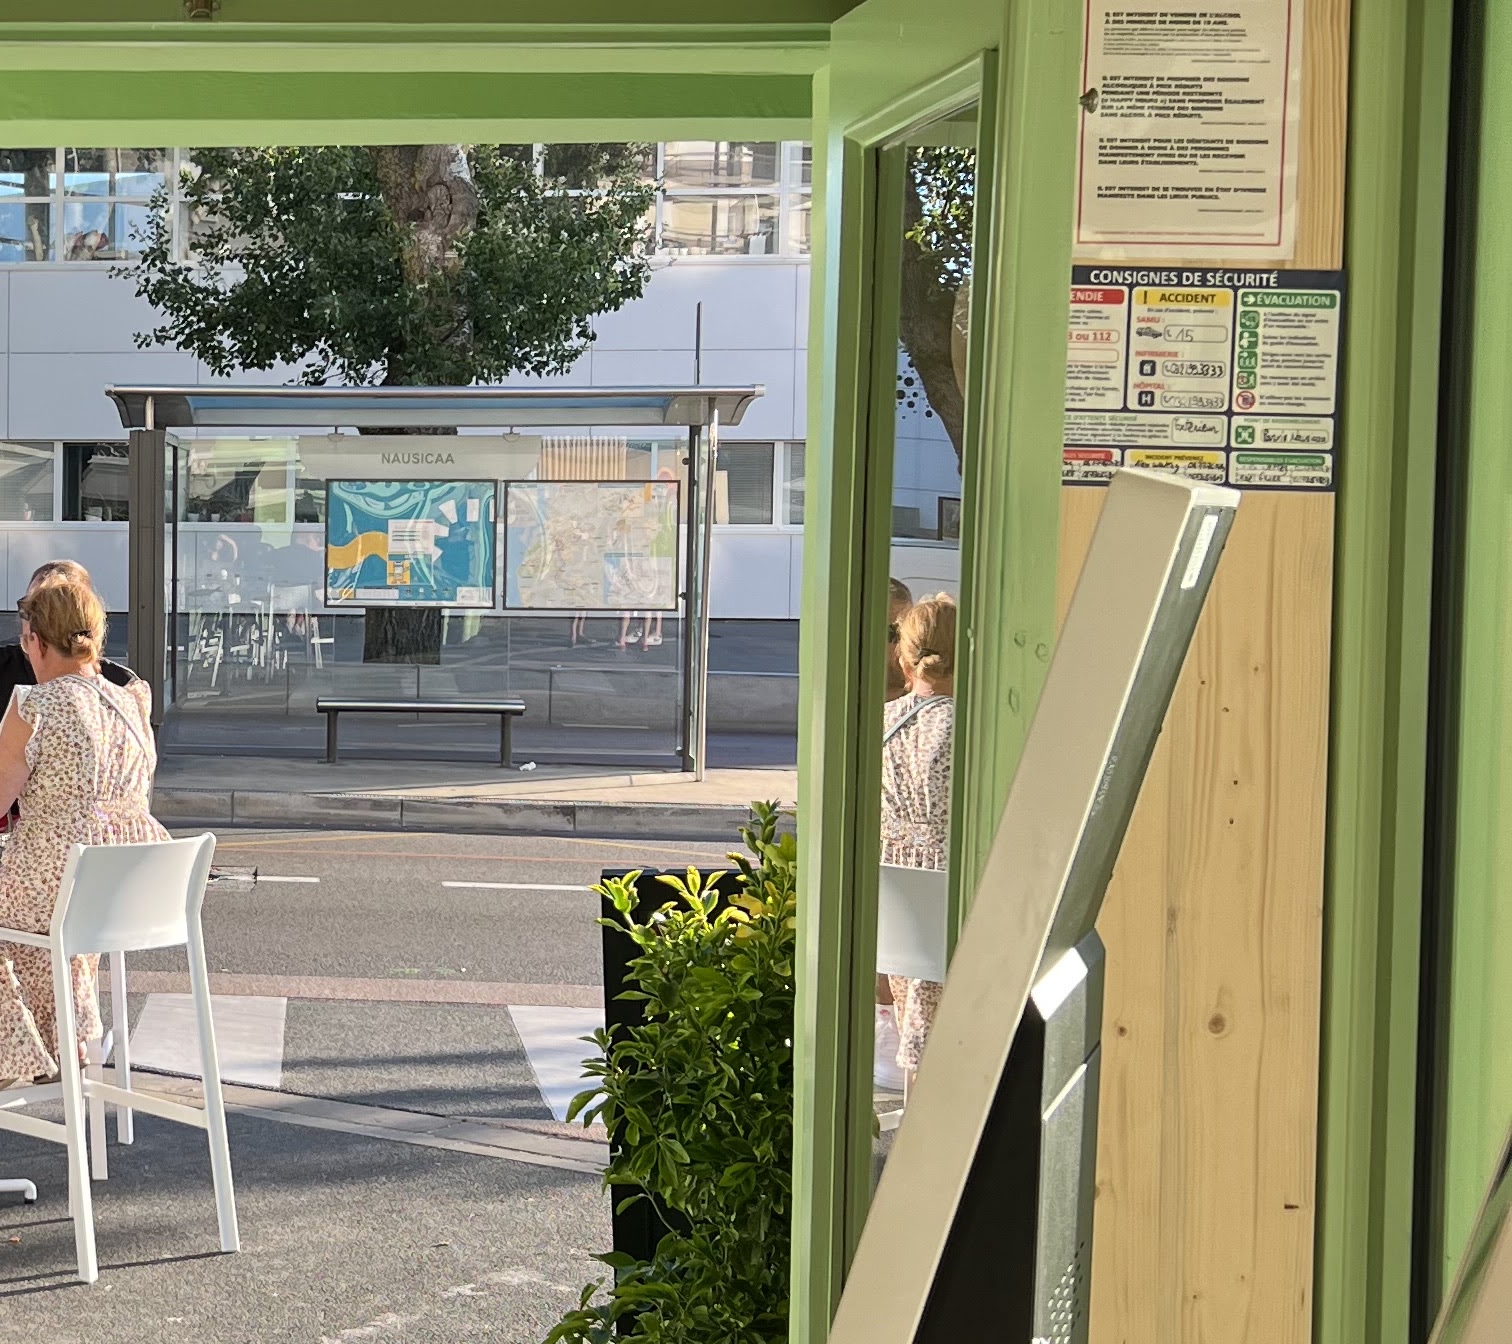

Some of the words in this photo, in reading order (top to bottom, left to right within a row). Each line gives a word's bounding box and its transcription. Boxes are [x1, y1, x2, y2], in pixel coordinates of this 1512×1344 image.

[1090, 270, 1178, 285] CONSIGNES
[1182, 272, 1202, 286] DE
[1206, 270, 1278, 287] SÉCURITÉ
[1159, 293, 1216, 304] ACCIDENT
[1257, 293, 1330, 306] ÉVACUATION
[1136, 316, 1160, 324] SAMU
[1092, 332, 1111, 342] 112
[381, 452, 455, 464] NAUSICAA
